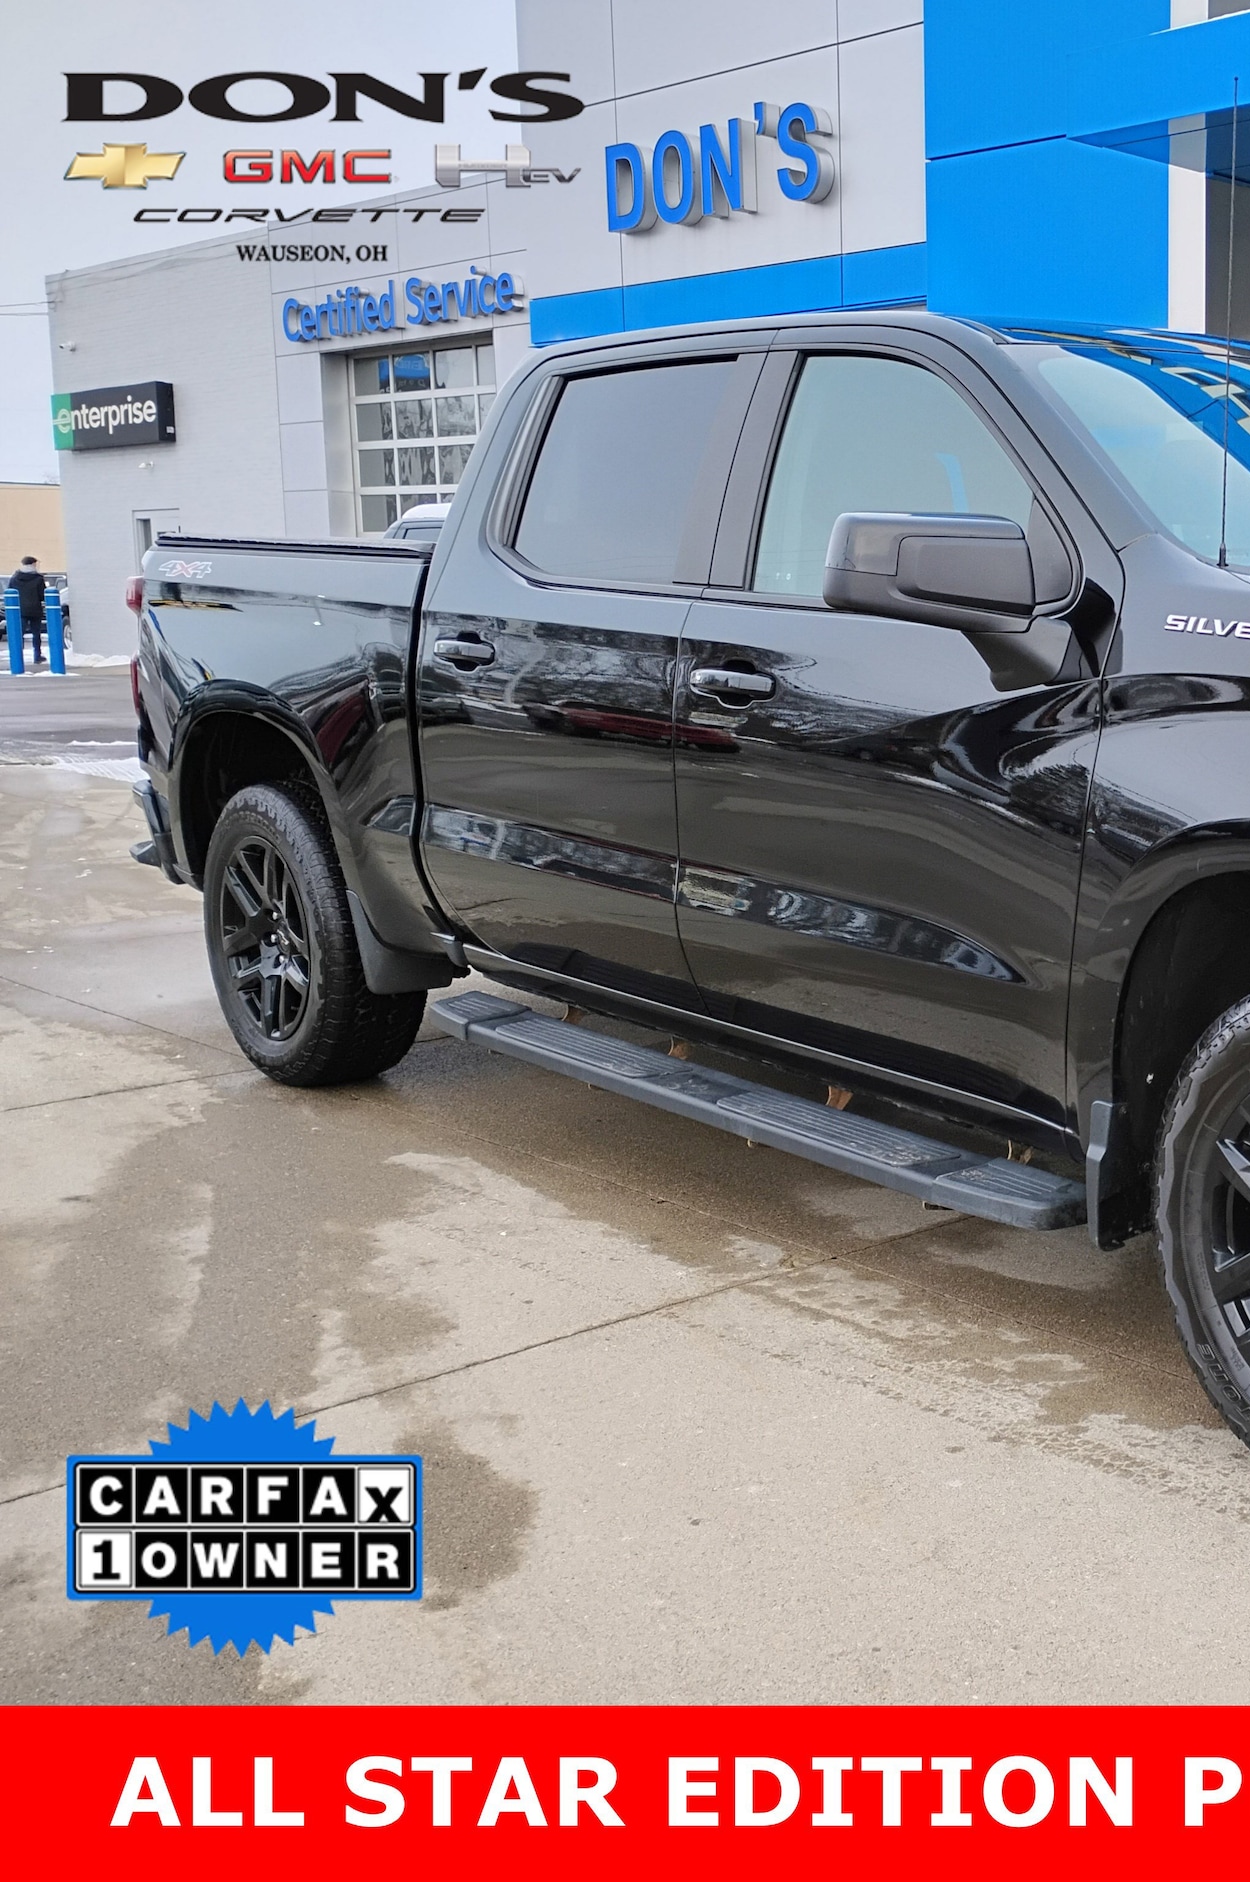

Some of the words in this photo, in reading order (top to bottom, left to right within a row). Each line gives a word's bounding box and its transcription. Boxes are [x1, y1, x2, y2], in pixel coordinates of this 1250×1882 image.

[605, 101, 833, 233] DON'S
[282, 279, 397, 342] Certified
[405, 265, 516, 326] Service
[53, 395, 157, 435] enterprise
